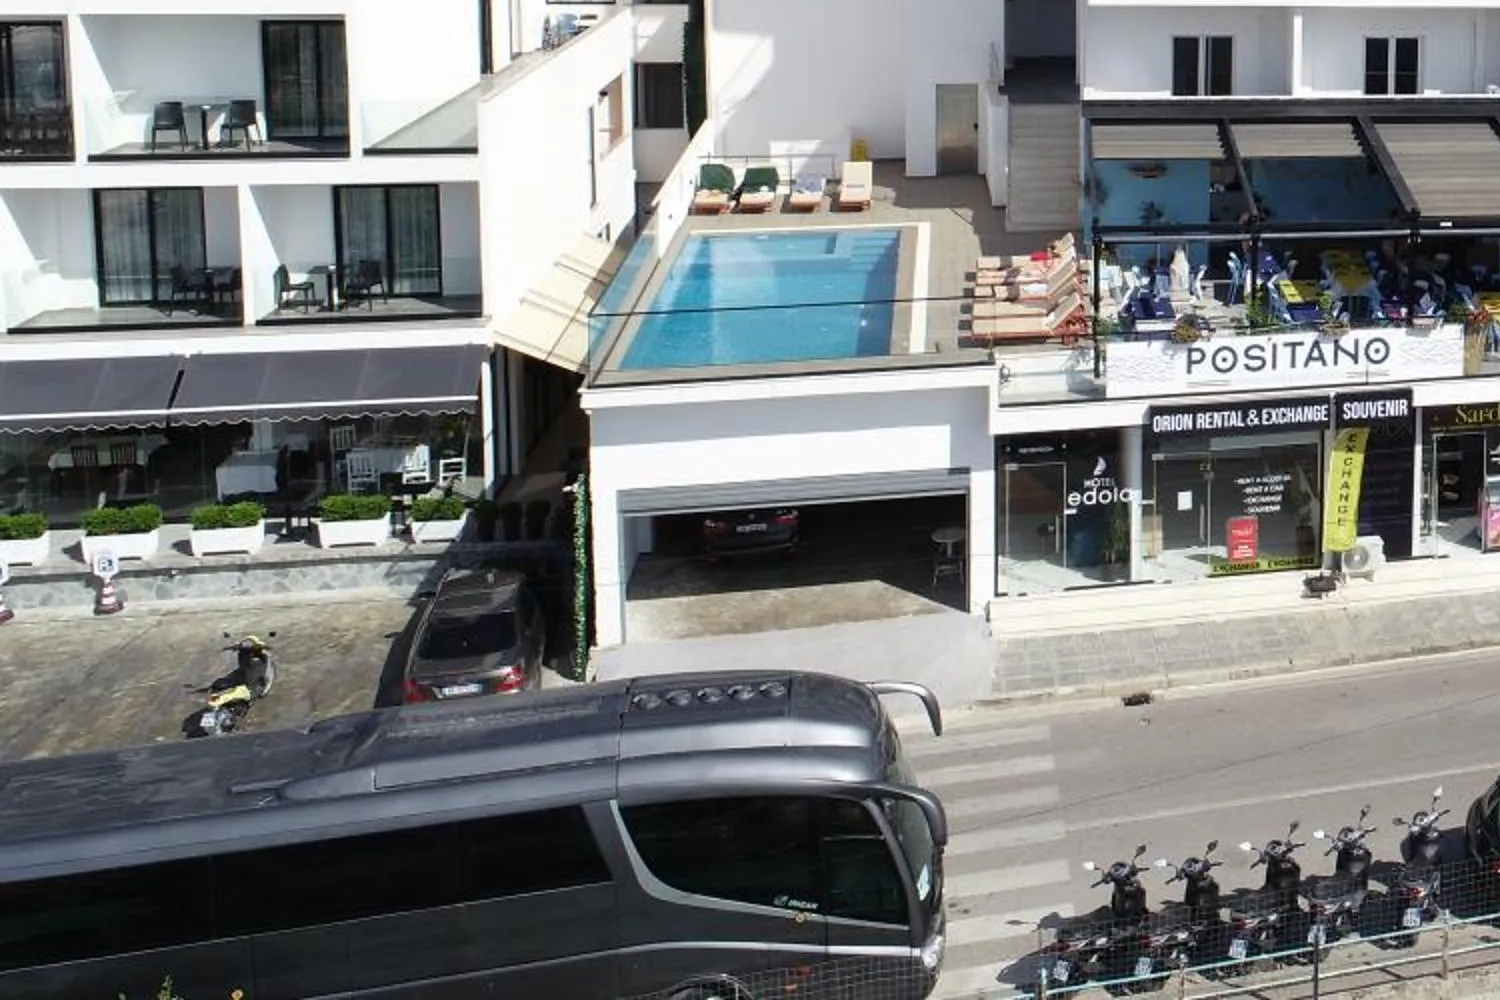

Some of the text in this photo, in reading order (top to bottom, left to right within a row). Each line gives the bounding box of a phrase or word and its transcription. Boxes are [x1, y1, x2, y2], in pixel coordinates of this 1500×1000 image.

[1186, 337, 1390, 374] POSITANO
[1153, 404, 1329, 433] ORION RENTAL & EXCHANGE
[1343, 399, 1408, 420] SOUVENIR
[1337, 433, 1357, 527] EXCHANGE
